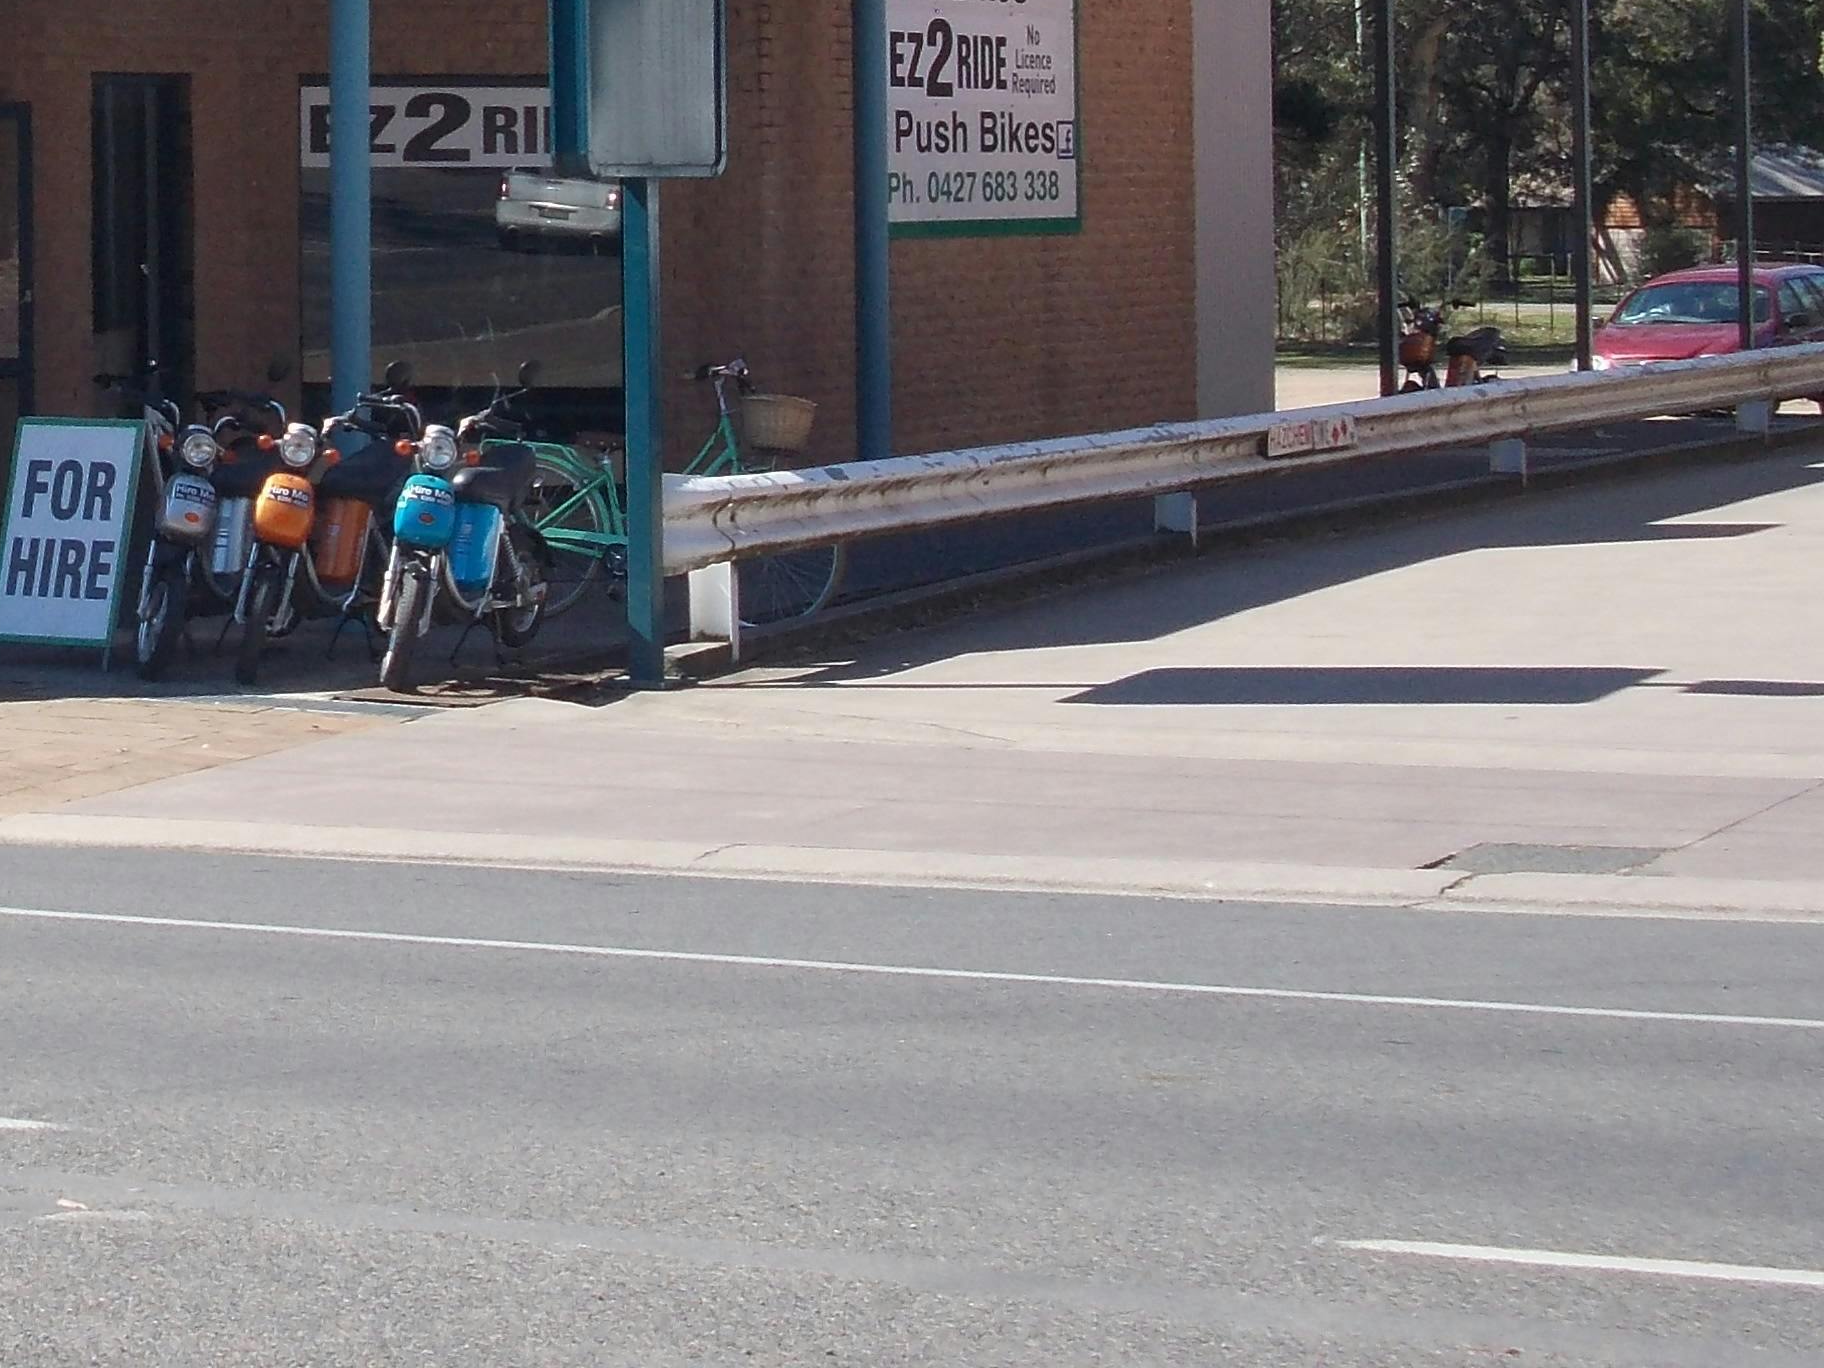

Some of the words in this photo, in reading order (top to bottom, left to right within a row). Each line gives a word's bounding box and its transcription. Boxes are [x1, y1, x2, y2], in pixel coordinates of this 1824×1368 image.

[1027, 25, 1041, 45] No
[1015, 48, 1052, 70] Licence
[1012, 72, 1056, 98] Required
[895, 109, 968, 154] Push
[980, 111, 1055, 154] Bikes
[888, 171, 920, 204] Ph.
[927, 171, 976, 203] 0427
[982, 170, 1018, 202] 683
[1024, 170, 1059, 201] 338
[21, 459, 116, 521] FOR
[5, 536, 115, 600] HIRE
